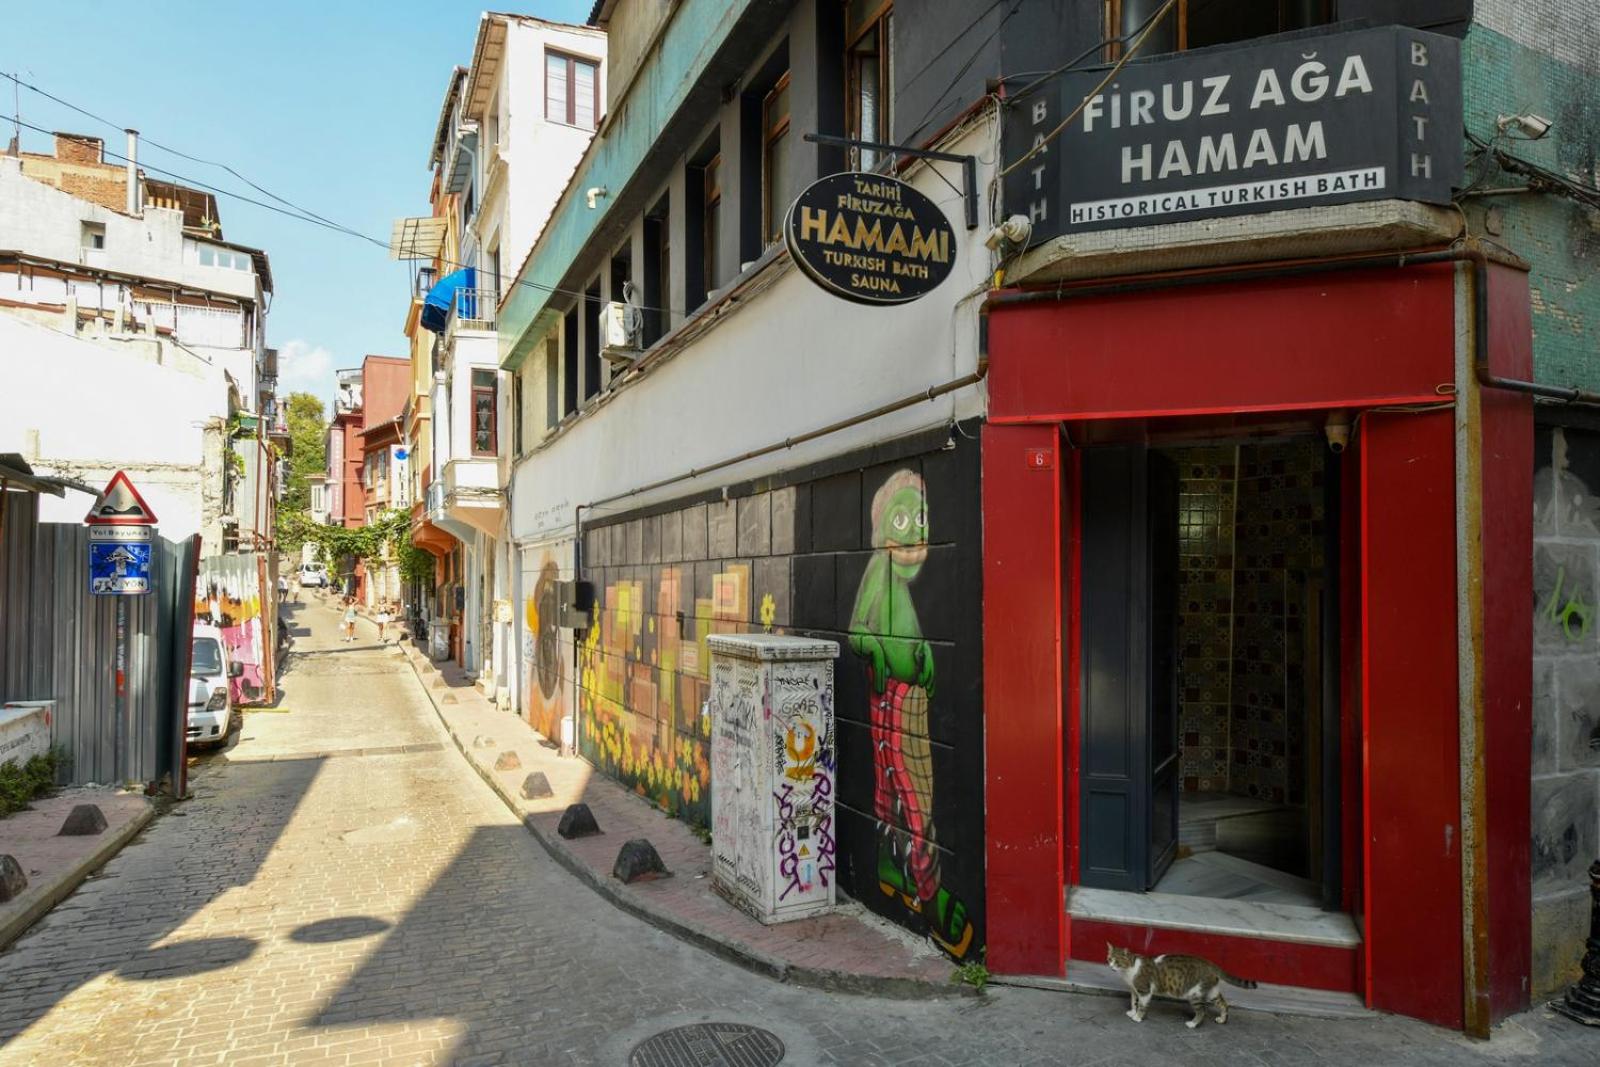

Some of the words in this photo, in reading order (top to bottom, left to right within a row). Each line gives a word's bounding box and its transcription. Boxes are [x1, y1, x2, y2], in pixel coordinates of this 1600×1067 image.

[1083, 74, 1232, 132] FİRUZ
[1250, 51, 1373, 109] AĞA
[1409, 42, 1432, 179] BATH
[1029, 101, 1048, 225] BATH
[1121, 120, 1327, 184] HAMAM
[854, 181, 901, 201] TARİHİ
[1072, 194, 1200, 223] HISTORICAL
[1208, 181, 1307, 206] TURKISH
[1317, 171, 1378, 193] BATH
[801, 206, 949, 264] HAMAMI
[824, 251, 886, 273] TURKISH
[892, 261, 928, 279] BATH
[851, 273, 901, 294] SAUNA
[1036, 454, 1044, 465] 6
